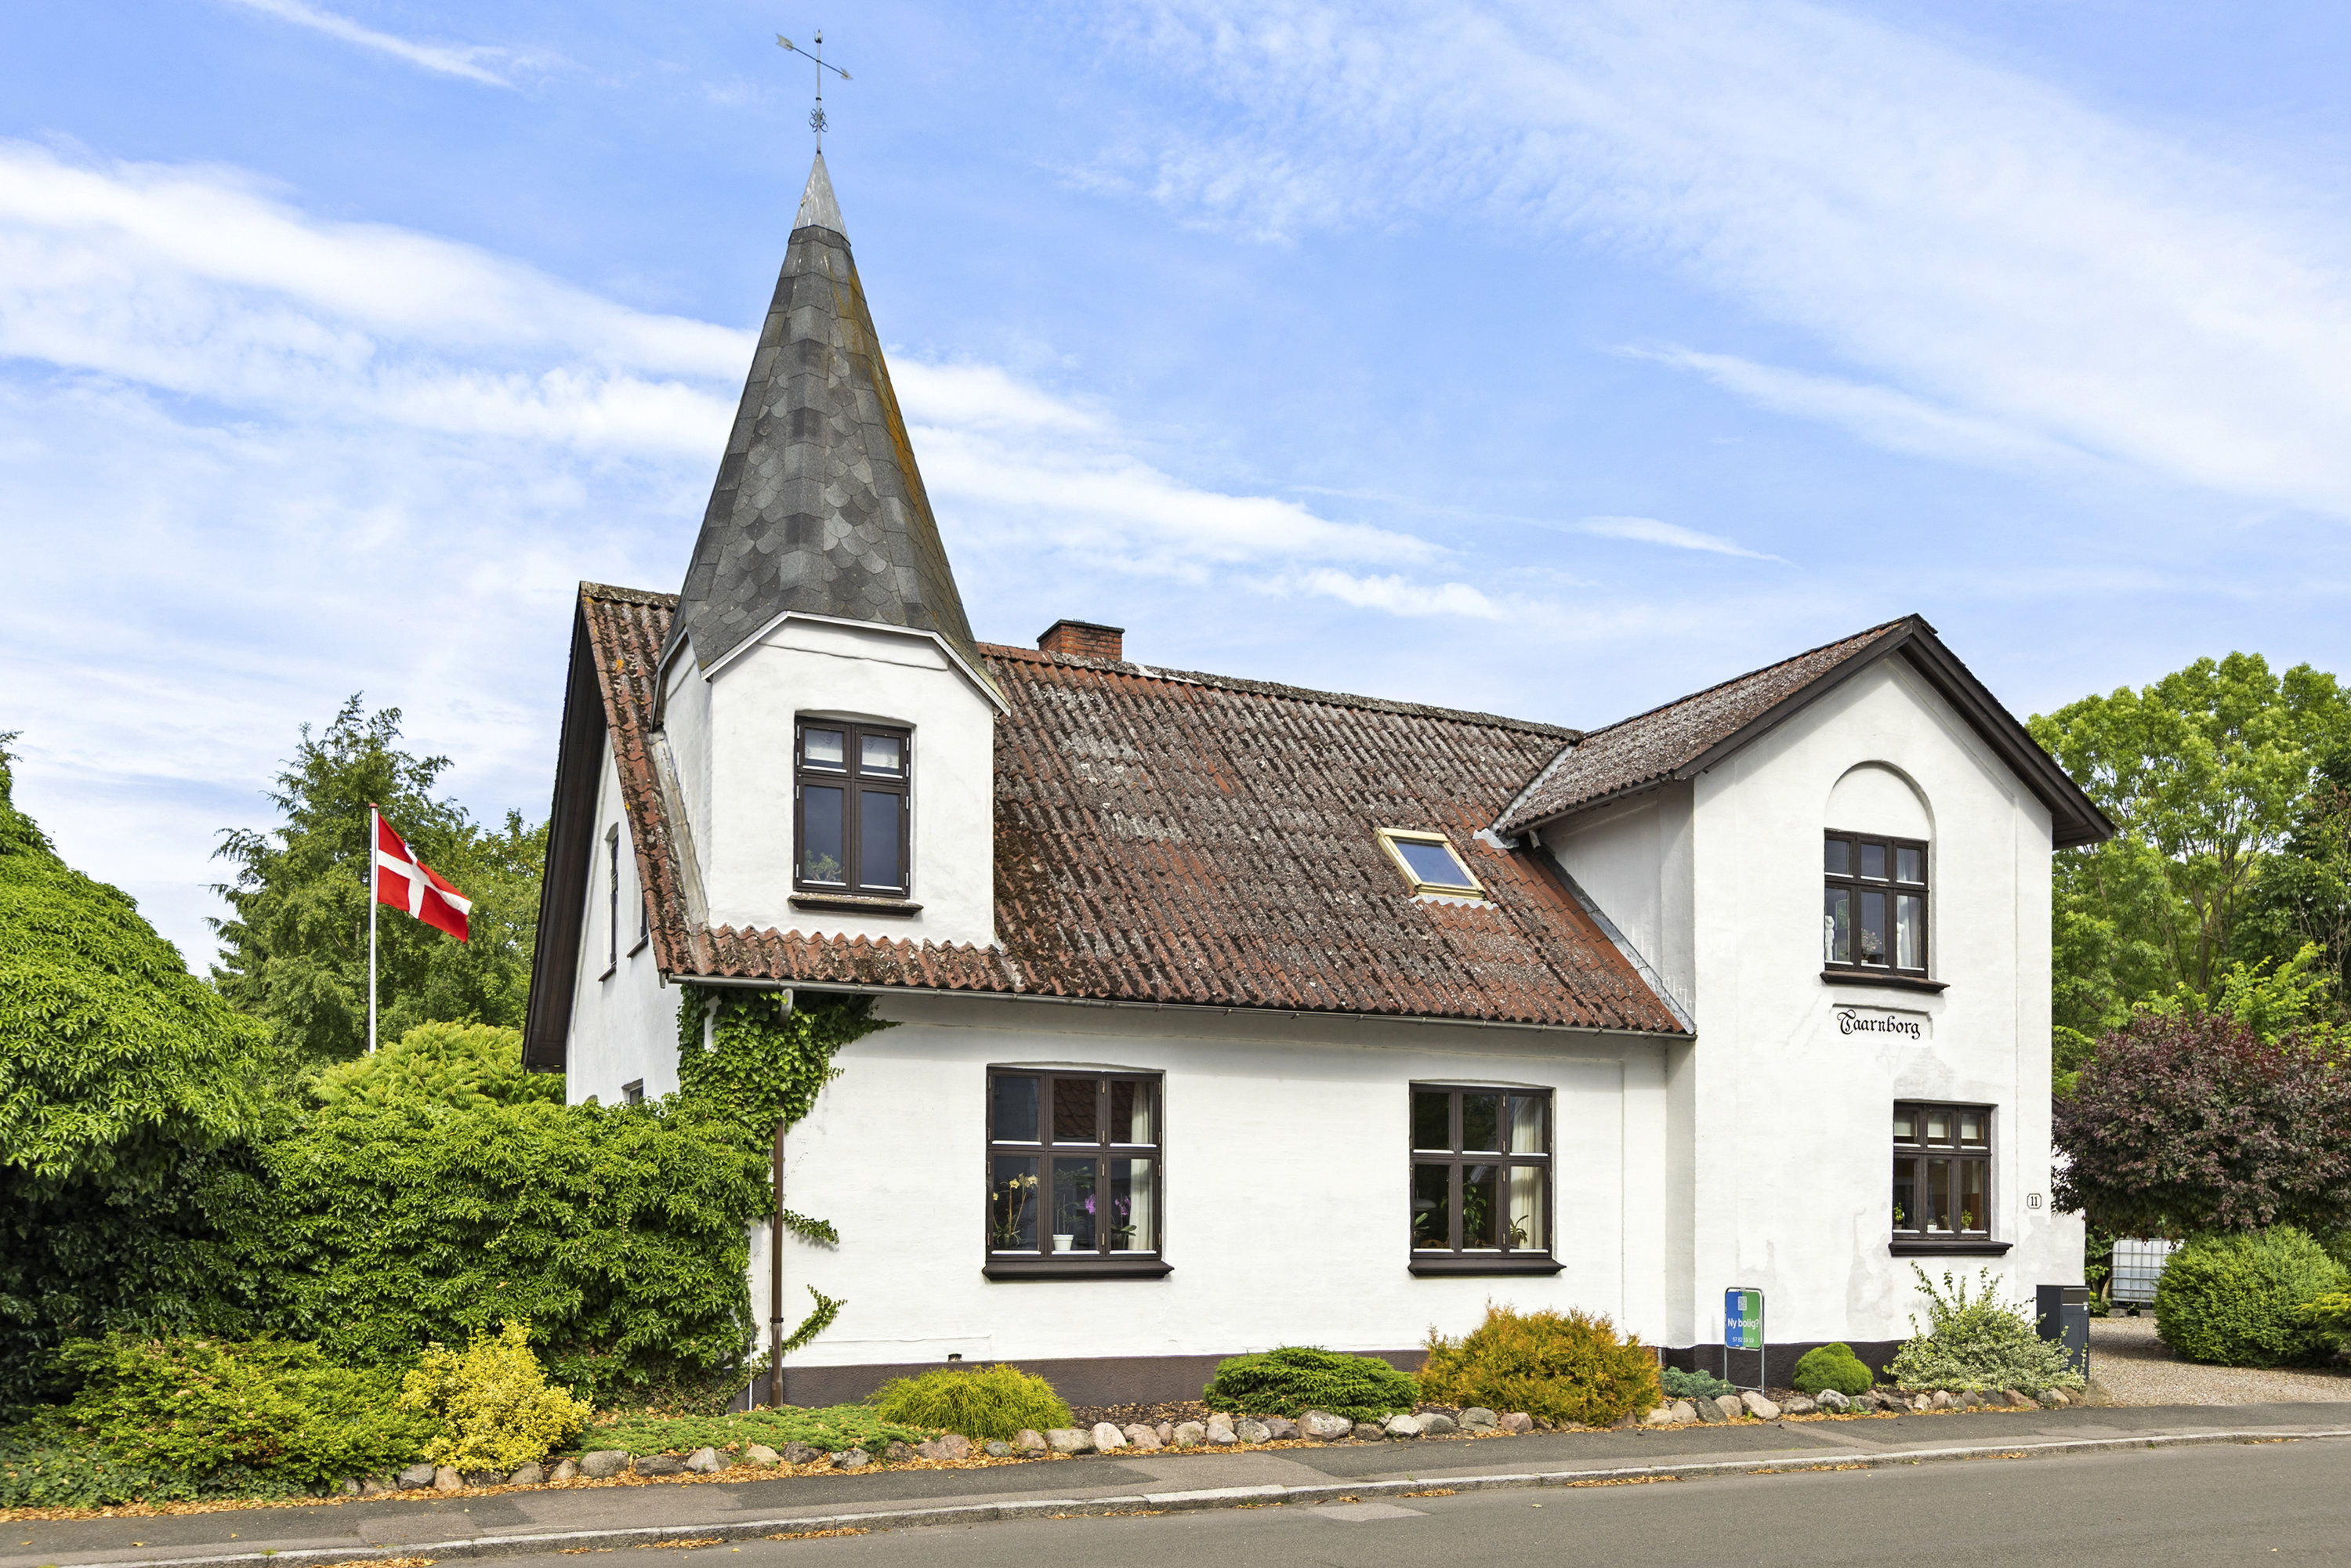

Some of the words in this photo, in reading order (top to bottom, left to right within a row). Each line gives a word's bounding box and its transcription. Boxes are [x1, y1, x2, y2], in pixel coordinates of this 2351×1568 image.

[1837, 1009, 1921, 1040] Taarnborg
[2030, 1196, 2038, 1206] 11
[1727, 1318, 1737, 1329] Ny
[1738, 1318, 1759, 1330] bolig?
